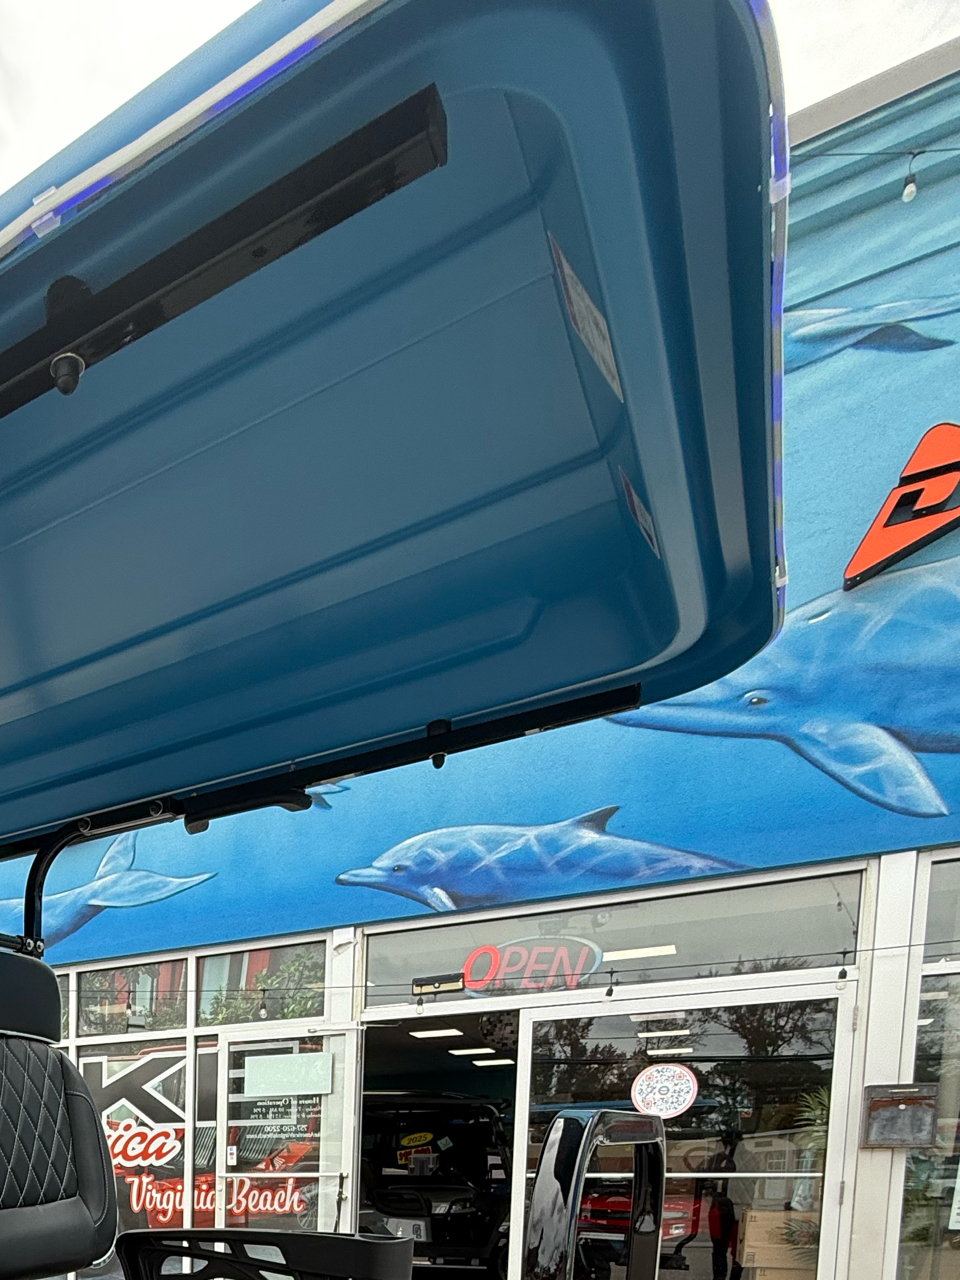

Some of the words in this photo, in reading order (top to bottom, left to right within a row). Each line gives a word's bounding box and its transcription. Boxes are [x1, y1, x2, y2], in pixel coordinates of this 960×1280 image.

[463, 945, 590, 989] OPEN
[78, 1041, 299, 1128] KE
[107, 1122, 178, 1163] ica
[406, 1134, 428, 1145] 2025
[229, 1176, 305, 1215] Beach
